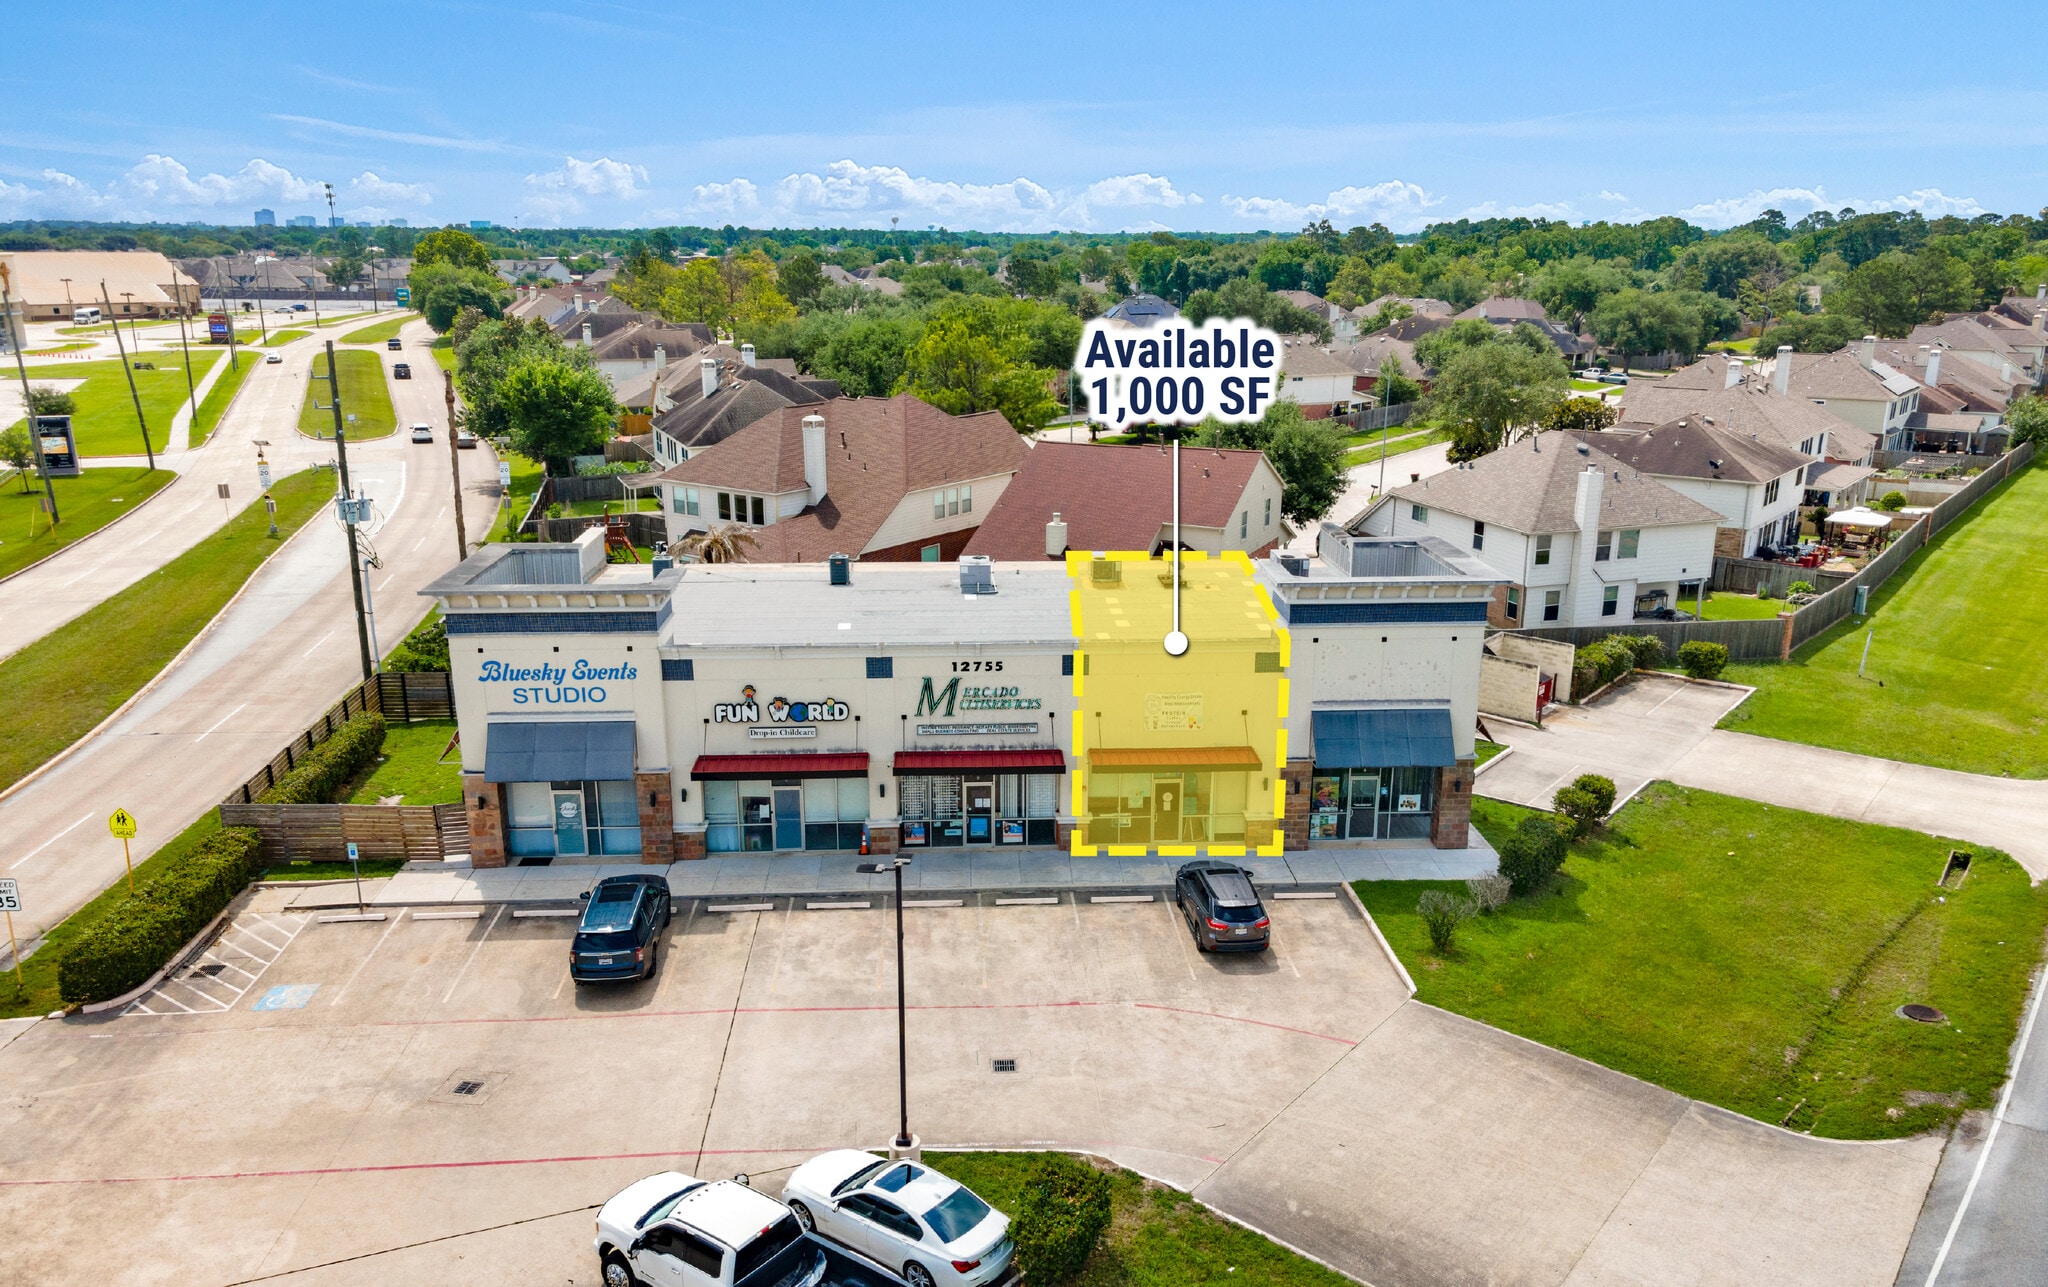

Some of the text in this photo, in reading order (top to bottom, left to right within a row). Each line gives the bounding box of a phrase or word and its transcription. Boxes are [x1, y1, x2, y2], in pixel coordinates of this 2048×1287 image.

[478, 658, 638, 686] Bluesky Events
[951, 661, 1004, 672] 12755
[512, 686, 607, 704] STUDIO
[714, 702, 850, 723] FUN WORLD
[750, 727, 816, 738] Drop-in Childcare
